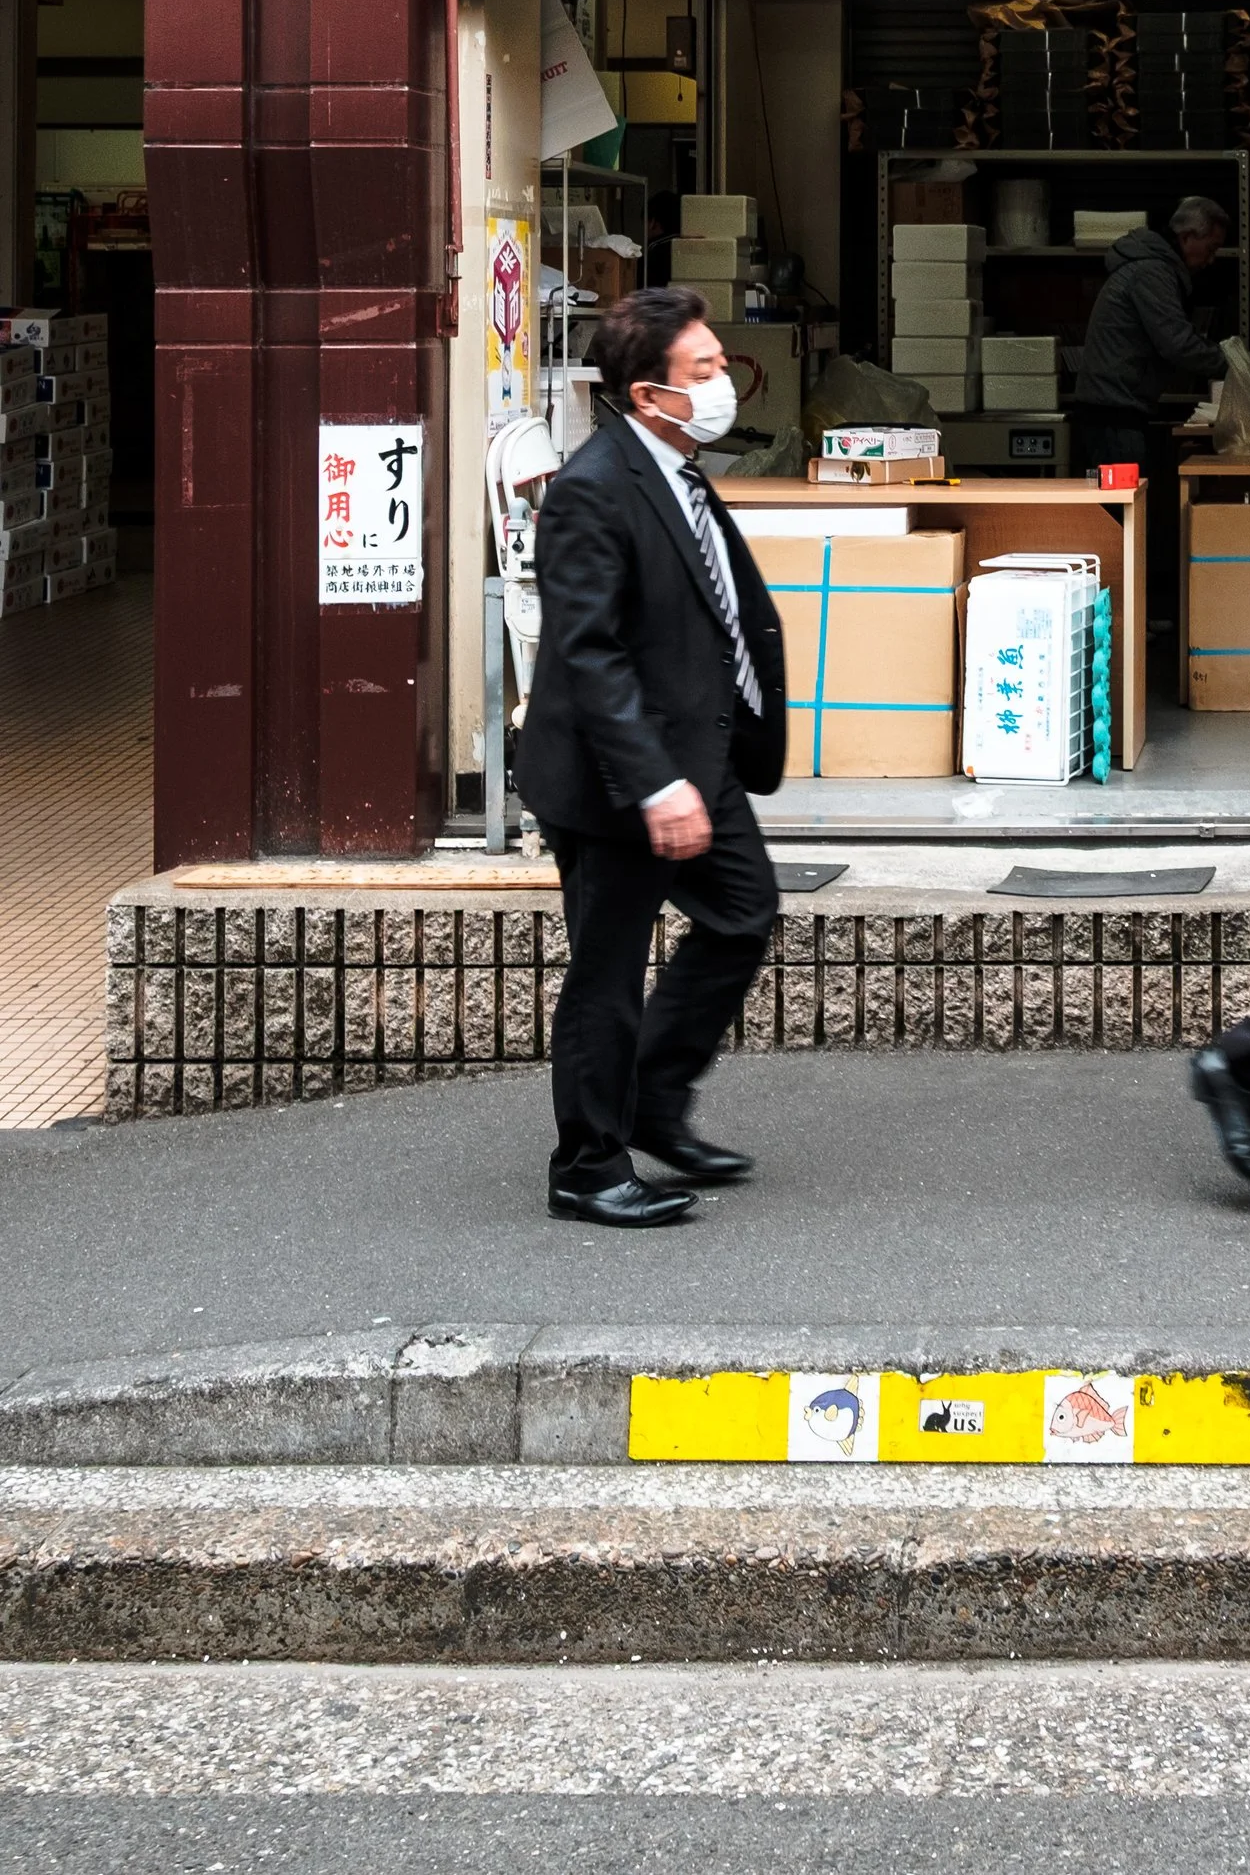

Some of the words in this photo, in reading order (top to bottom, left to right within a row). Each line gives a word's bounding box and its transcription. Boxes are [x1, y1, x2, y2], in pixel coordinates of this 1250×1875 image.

[323, 452, 356, 549] 御用心
[379, 437, 418, 543] すり
[362, 533, 378, 548] に
[996, 644, 1024, 735] 柳葉魚
[953, 1418, 982, 1433] us.
